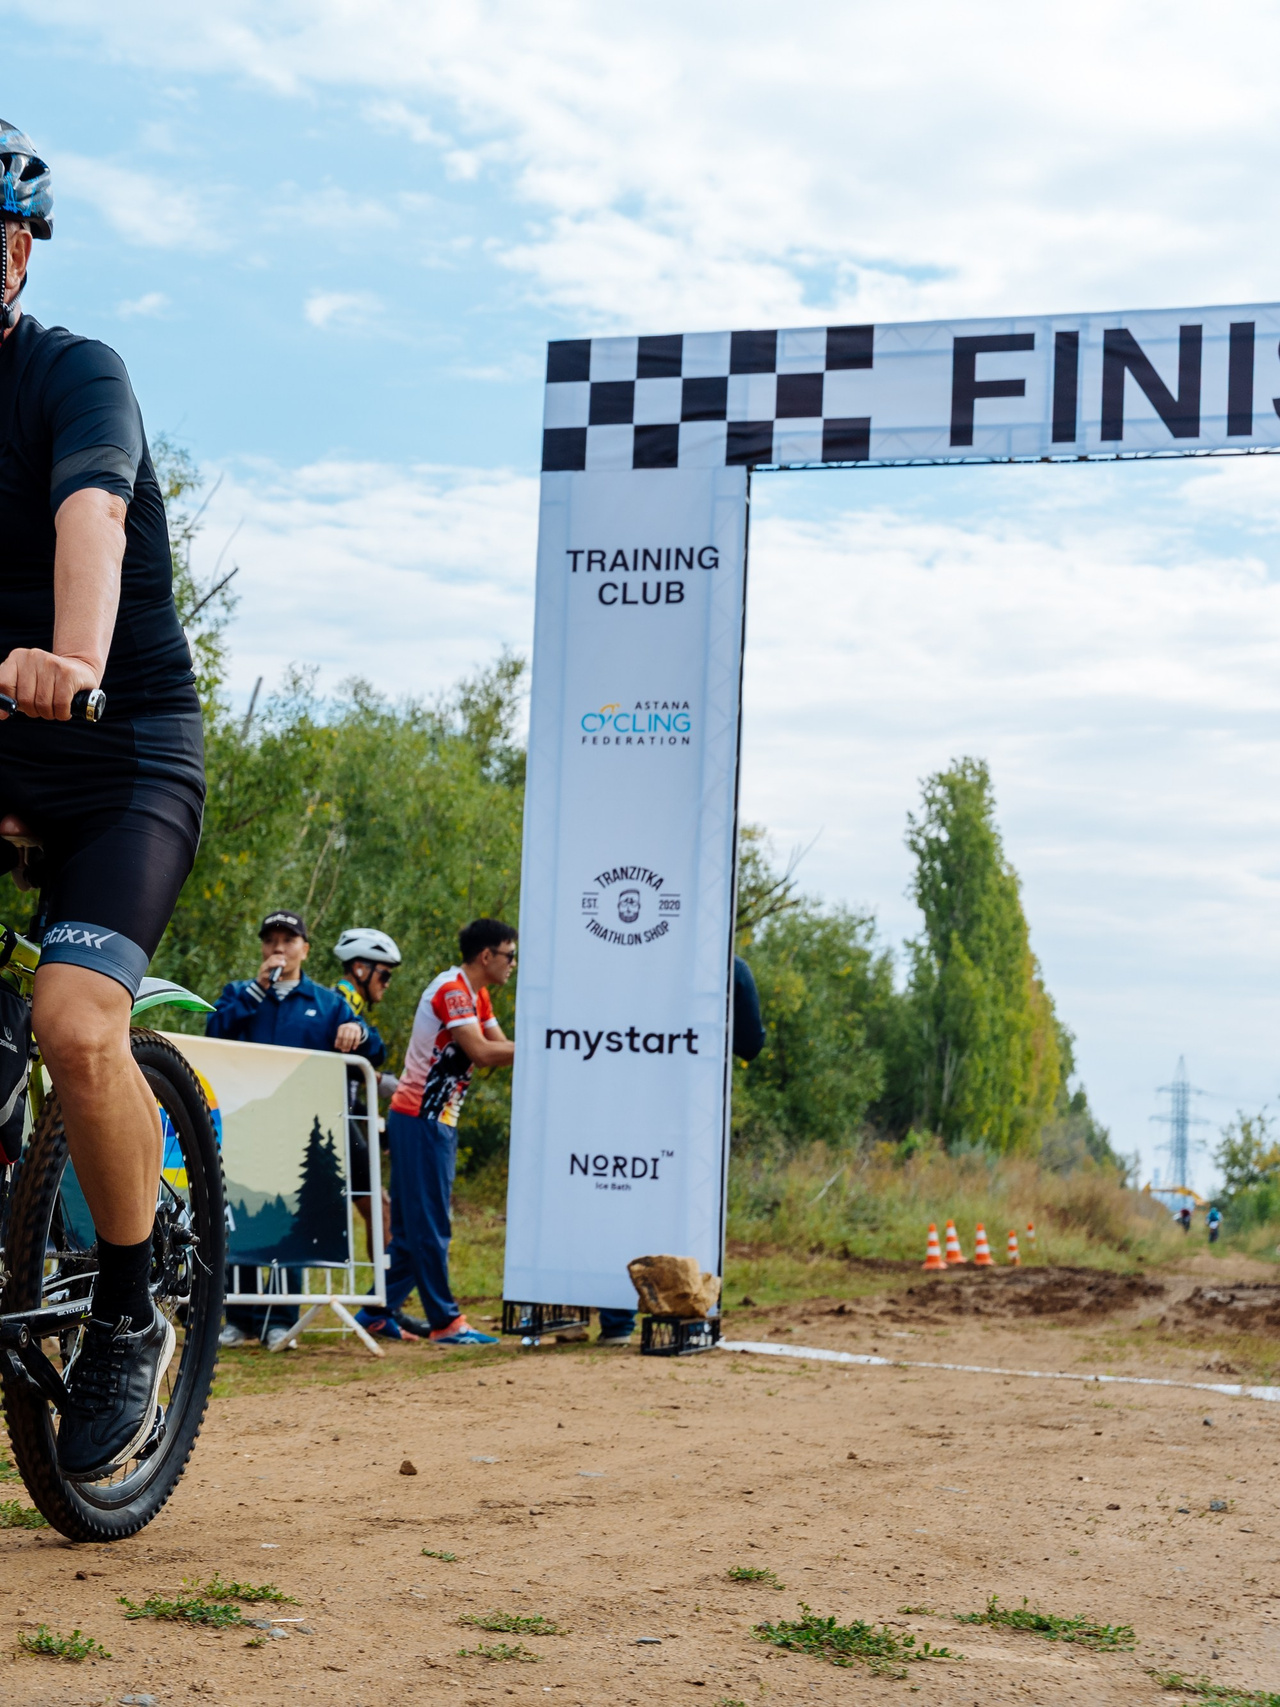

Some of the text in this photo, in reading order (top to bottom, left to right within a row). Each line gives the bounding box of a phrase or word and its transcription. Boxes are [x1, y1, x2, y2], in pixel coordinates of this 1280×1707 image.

[949, 321, 1280, 447] FINI
[565, 545, 720, 573] TRAINING
[598, 580, 685, 606] CLUB
[634, 700, 690, 710] ASTANA
[581, 712, 691, 733] CYCLING
[581, 736, 690, 745] FEDERATION
[593, 865, 664, 891] TRANZITKA
[582, 898, 680, 911] EST. 2020
[585, 918, 669, 946] TRIATHLON SHOP
[545, 1025, 699, 1061] mystart
[595, 1182, 631, 1191] Ice Bath
